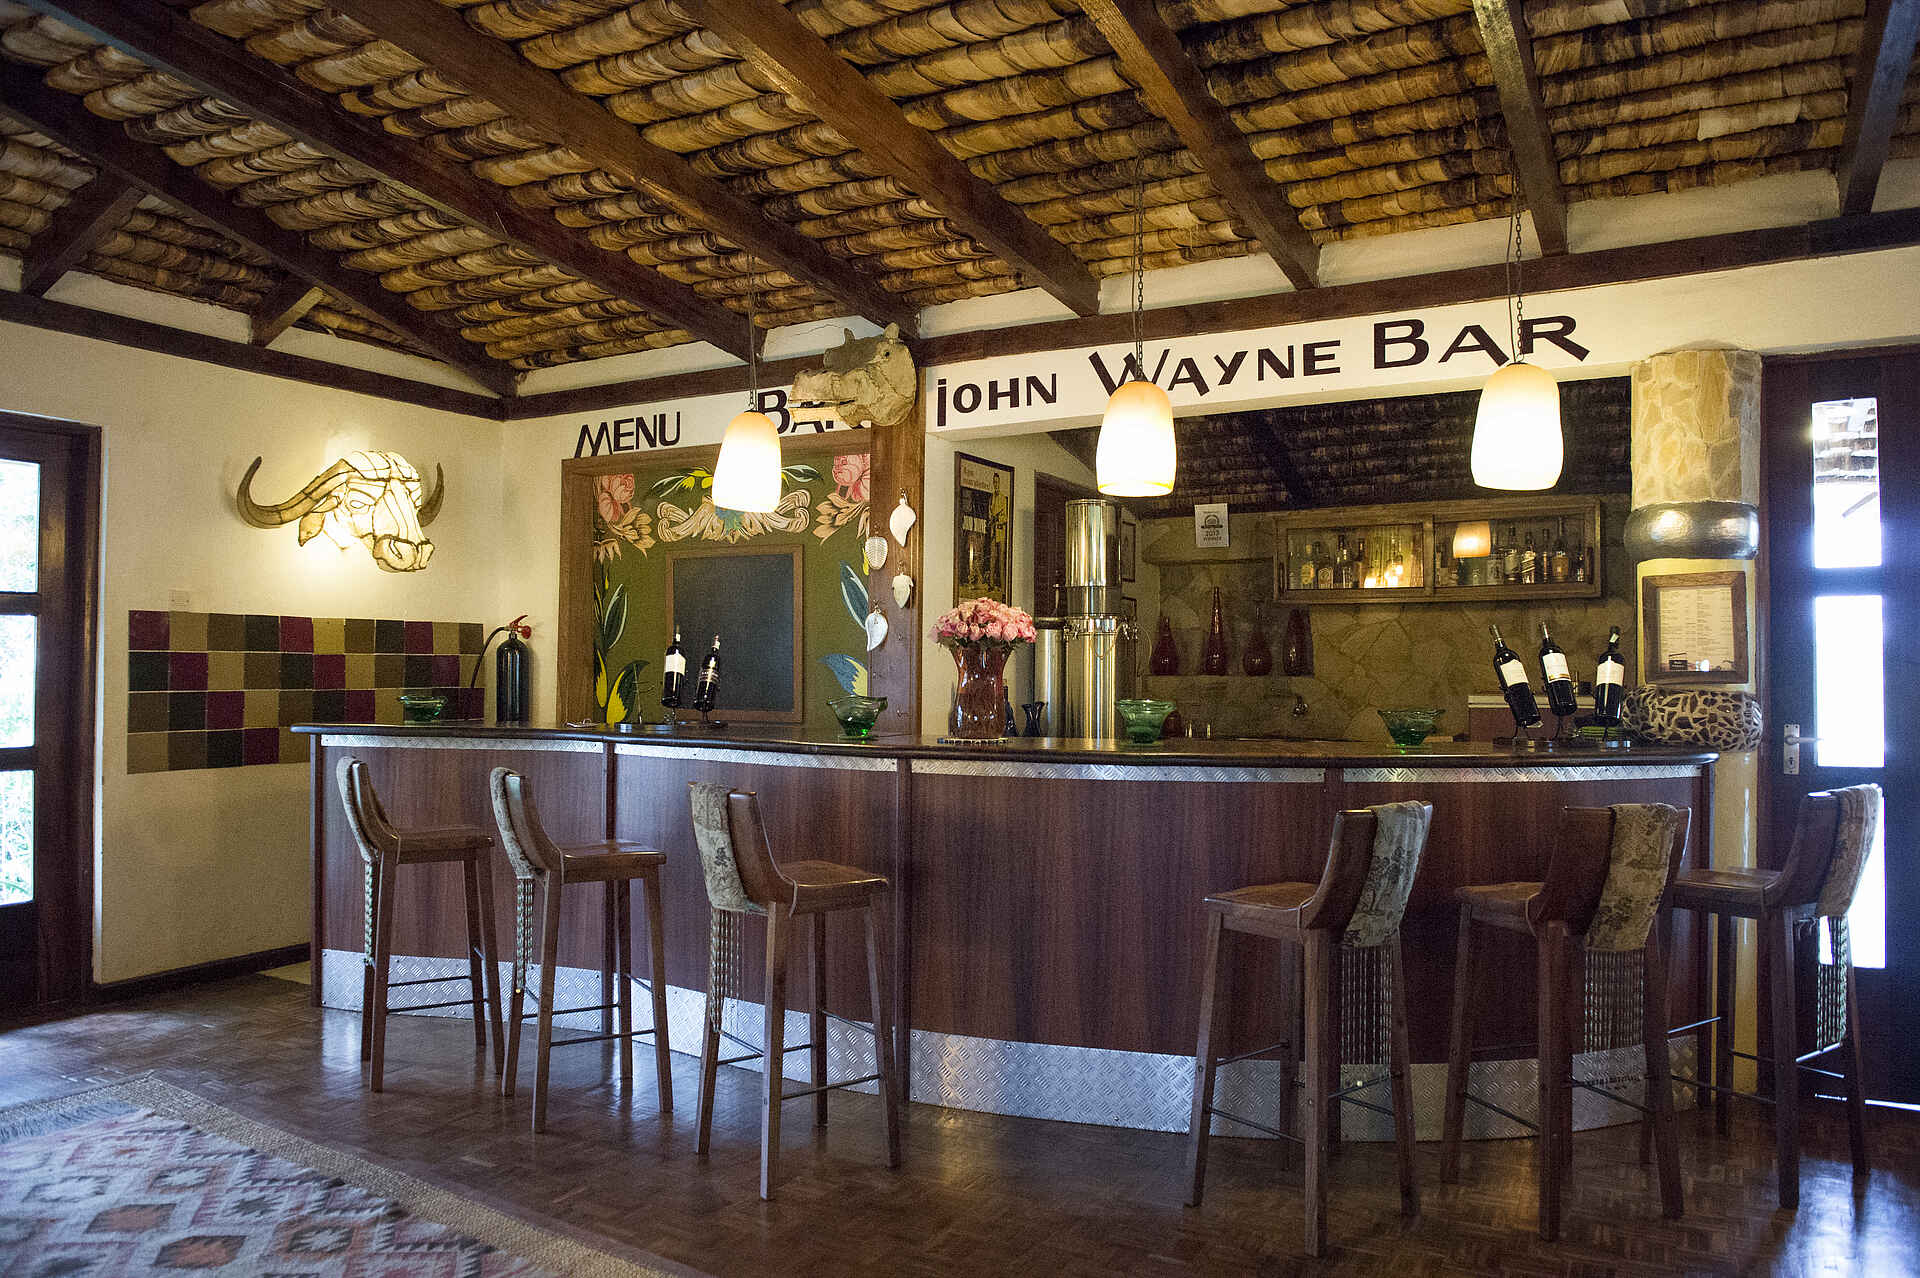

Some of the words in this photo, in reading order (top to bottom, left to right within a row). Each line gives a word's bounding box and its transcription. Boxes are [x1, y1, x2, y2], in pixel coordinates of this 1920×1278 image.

[1088, 340, 1341, 397] WAYNE
[1373, 315, 1591, 369] BAR
[574, 411, 681, 458] MENU
[757, 389, 865, 434] BA
